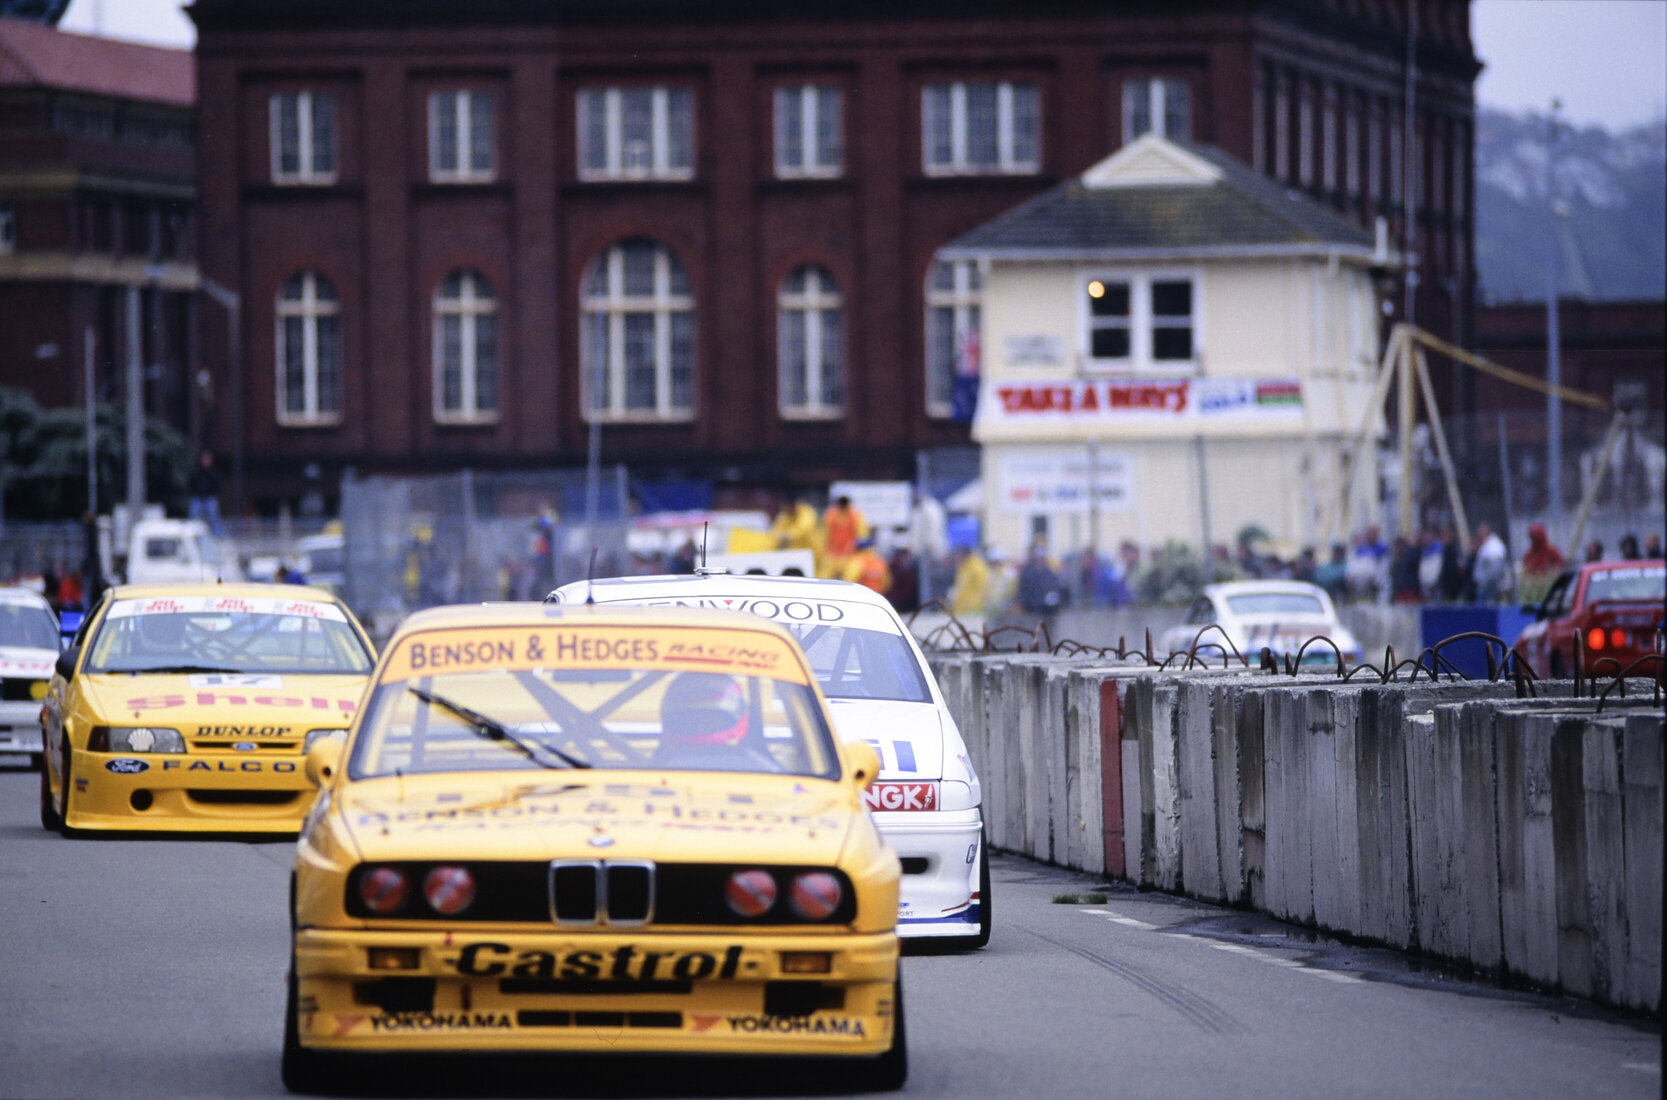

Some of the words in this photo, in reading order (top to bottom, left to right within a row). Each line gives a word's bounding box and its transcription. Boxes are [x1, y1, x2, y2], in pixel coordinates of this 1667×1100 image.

[411, 643, 514, 669] BENSON
[526, 635, 544, 661] &
[558, 634, 658, 662] HEDGES
[668, 642, 781, 664] RACING
[195, 726, 291, 737] DUNLOP
[111, 758, 143, 773] Ford
[864, 786, 923, 809] NGK
[456, 943, 743, 980] Castrol
[370, 1014, 512, 1031] YOKOHAMA
[727, 1016, 866, 1038] YOKOHAMA
